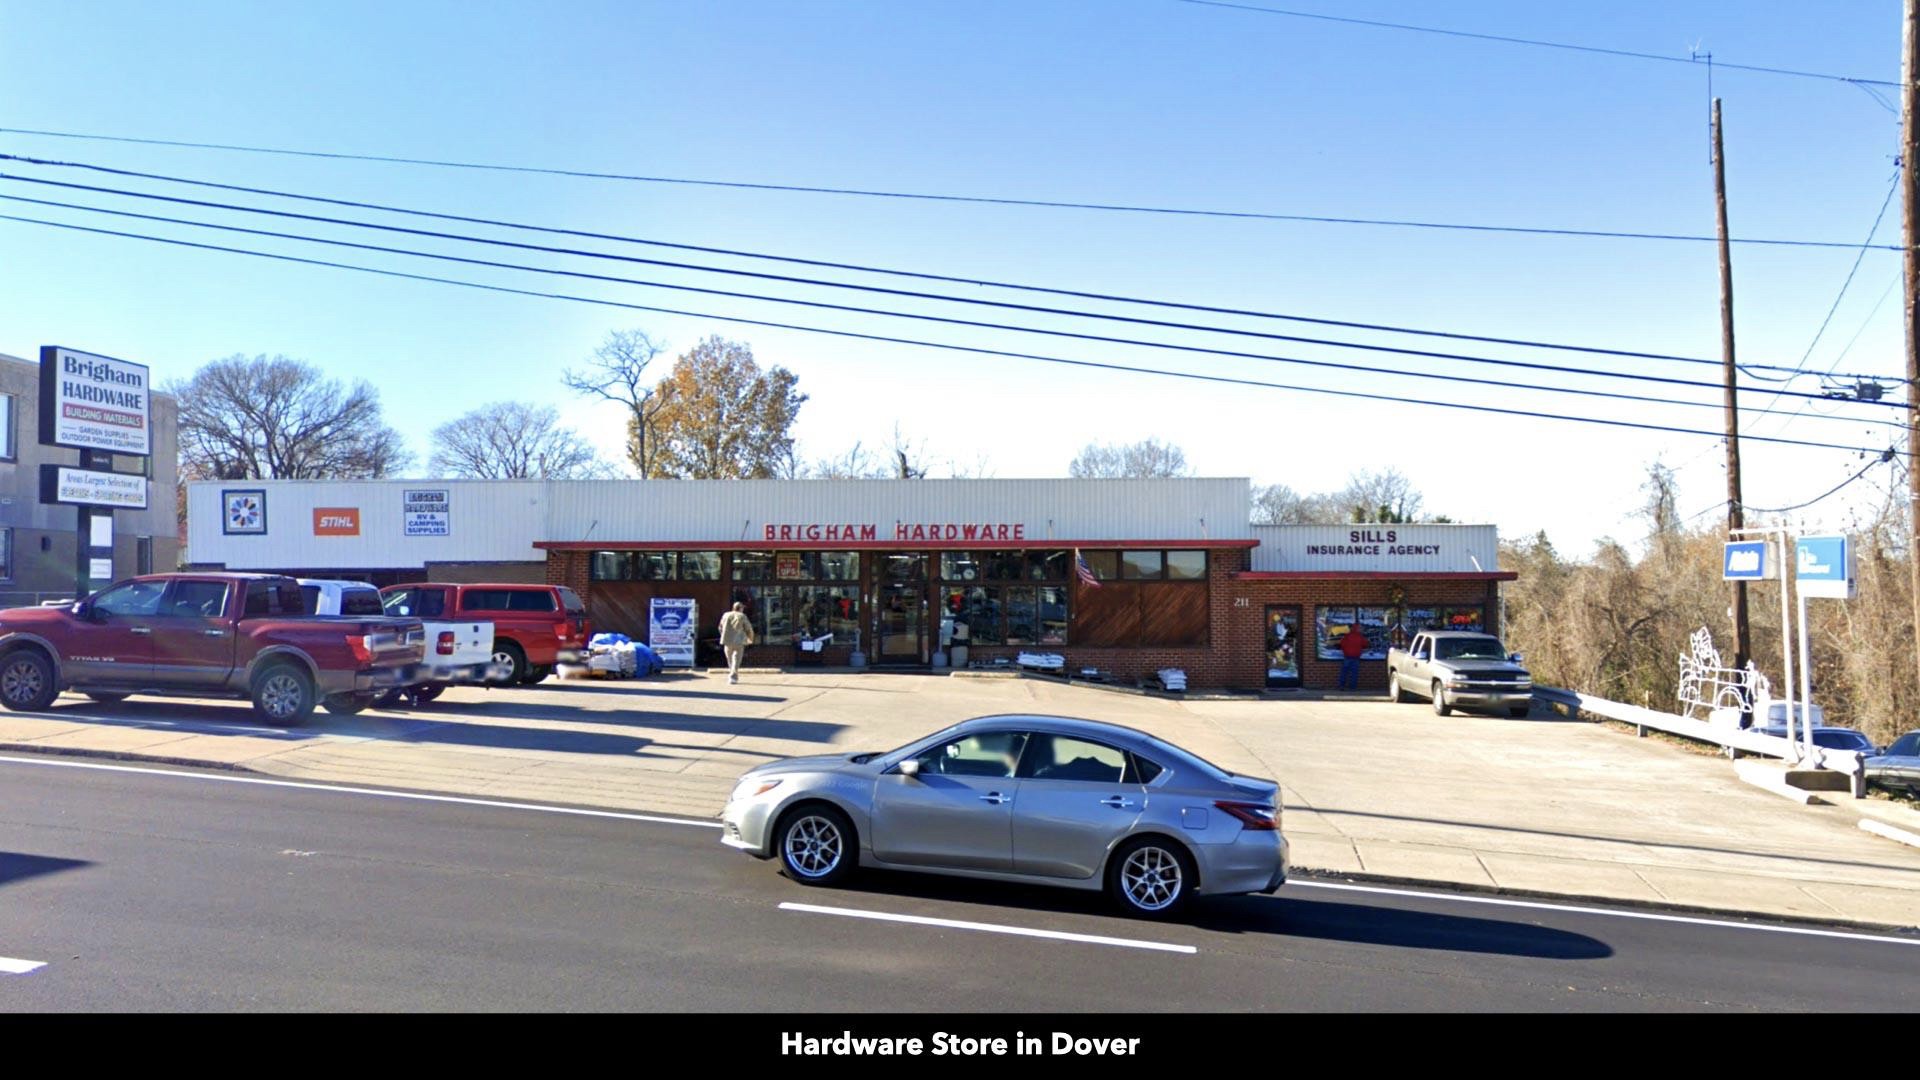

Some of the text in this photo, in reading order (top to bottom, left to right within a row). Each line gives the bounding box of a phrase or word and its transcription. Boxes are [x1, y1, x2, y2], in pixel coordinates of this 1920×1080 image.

[64, 356, 142, 387] Brigham
[63, 381, 143, 410] HARDWARE
[65, 405, 141, 426] BUILDING MATERIALS
[79, 426, 103, 436] GARDEN
[61, 432, 92, 443] OUTDOOR
[92, 435, 113, 446] POWER
[319, 516, 353, 528] STIHL
[765, 523, 1025, 540] BRIGHAM HARDWARE
[1350, 530, 1397, 543] SILLS
[1307, 545, 1440, 555] INSURANCE AGENCY
[1233, 597, 1249, 607] 211
